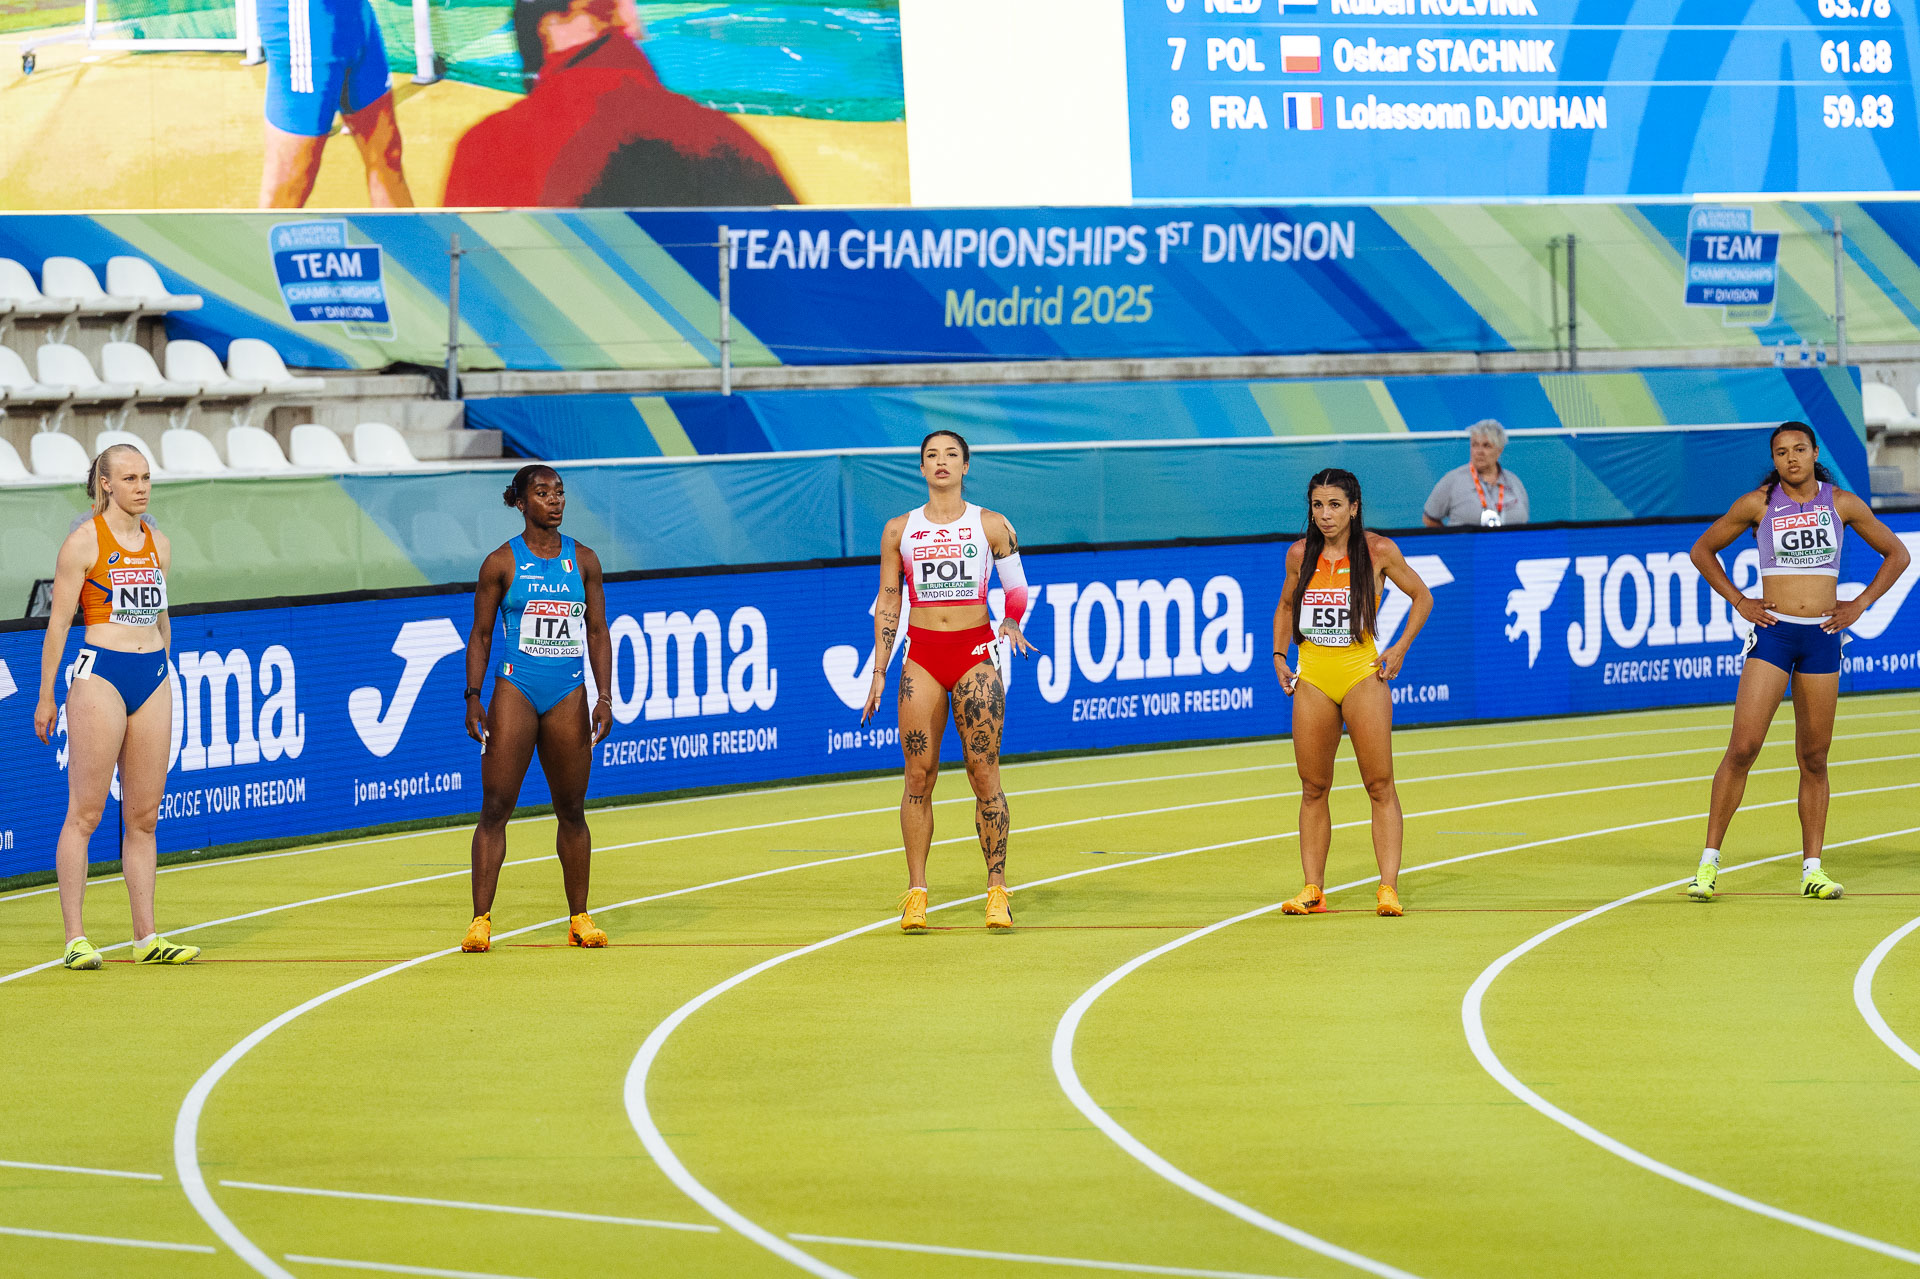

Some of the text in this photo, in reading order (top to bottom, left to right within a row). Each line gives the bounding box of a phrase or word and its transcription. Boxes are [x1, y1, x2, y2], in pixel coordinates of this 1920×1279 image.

[1167, 37, 1265, 72] 7 POL
[1333, 37, 1557, 73] Oskar STACHNIK
[1820, 39, 1893, 73] 61.88
[1171, 95, 1268, 130] 8 FRA
[1336, 94, 1608, 130] Lolassonn DJOUHAN
[1823, 94, 1895, 129] 59.83
[727, 228, 830, 270] TEAM
[838, 225, 1148, 271] CHAMPIONSHIPS
[1201, 220, 1355, 263] DIVISION
[1703, 235, 1763, 260] TEAM
[290, 251, 363, 279] TEAM
[1691, 266, 1773, 281] CHAMPIONSHIPS
[287, 286, 381, 300] CHAMPIONSHIPS
[1715, 287, 1760, 302] DIVISION
[324, 304, 375, 319] DIVISION
[944, 284, 1154, 328] Madrid 2025
[1774, 514, 1818, 530] SPAR
[1781, 528, 1832, 551] GBR
[914, 545, 960, 560] SPAR
[1781, 557, 1814, 565] MADRID
[113, 571, 155, 583] SPAR
[922, 560, 973, 583] POL
[120, 586, 162, 608] NED
[528, 583, 571, 593] ITALIA
[921, 589, 974, 599] MADRID 2025
[1304, 592, 1346, 604] SPAR
[116, 613, 150, 624] MADRID
[525, 602, 569, 615] SPAR
[1312, 607, 1351, 628] ESP
[535, 617, 571, 639] ITA
[524, 645, 579, 655] MADRID 2025
[1338, 636, 1353, 644] 202
[78, 654, 90, 675] 7
[1603, 658, 1670, 685] EXERCISE
[1673, 655, 1713, 680] YOUR
[584, 606, 778, 752] oma
[1072, 686, 1254, 722] EXERCISE YOUR FREEDOM
[1391, 683, 1450, 704] ort.com
[602, 726, 778, 767] EXERCISE YOUR FREEDOM
[827, 726, 900, 755] joma-spor
[157, 776, 306, 820] ERCISE YOUR FREEDOM
[354, 771, 462, 807] joma-sport.com
